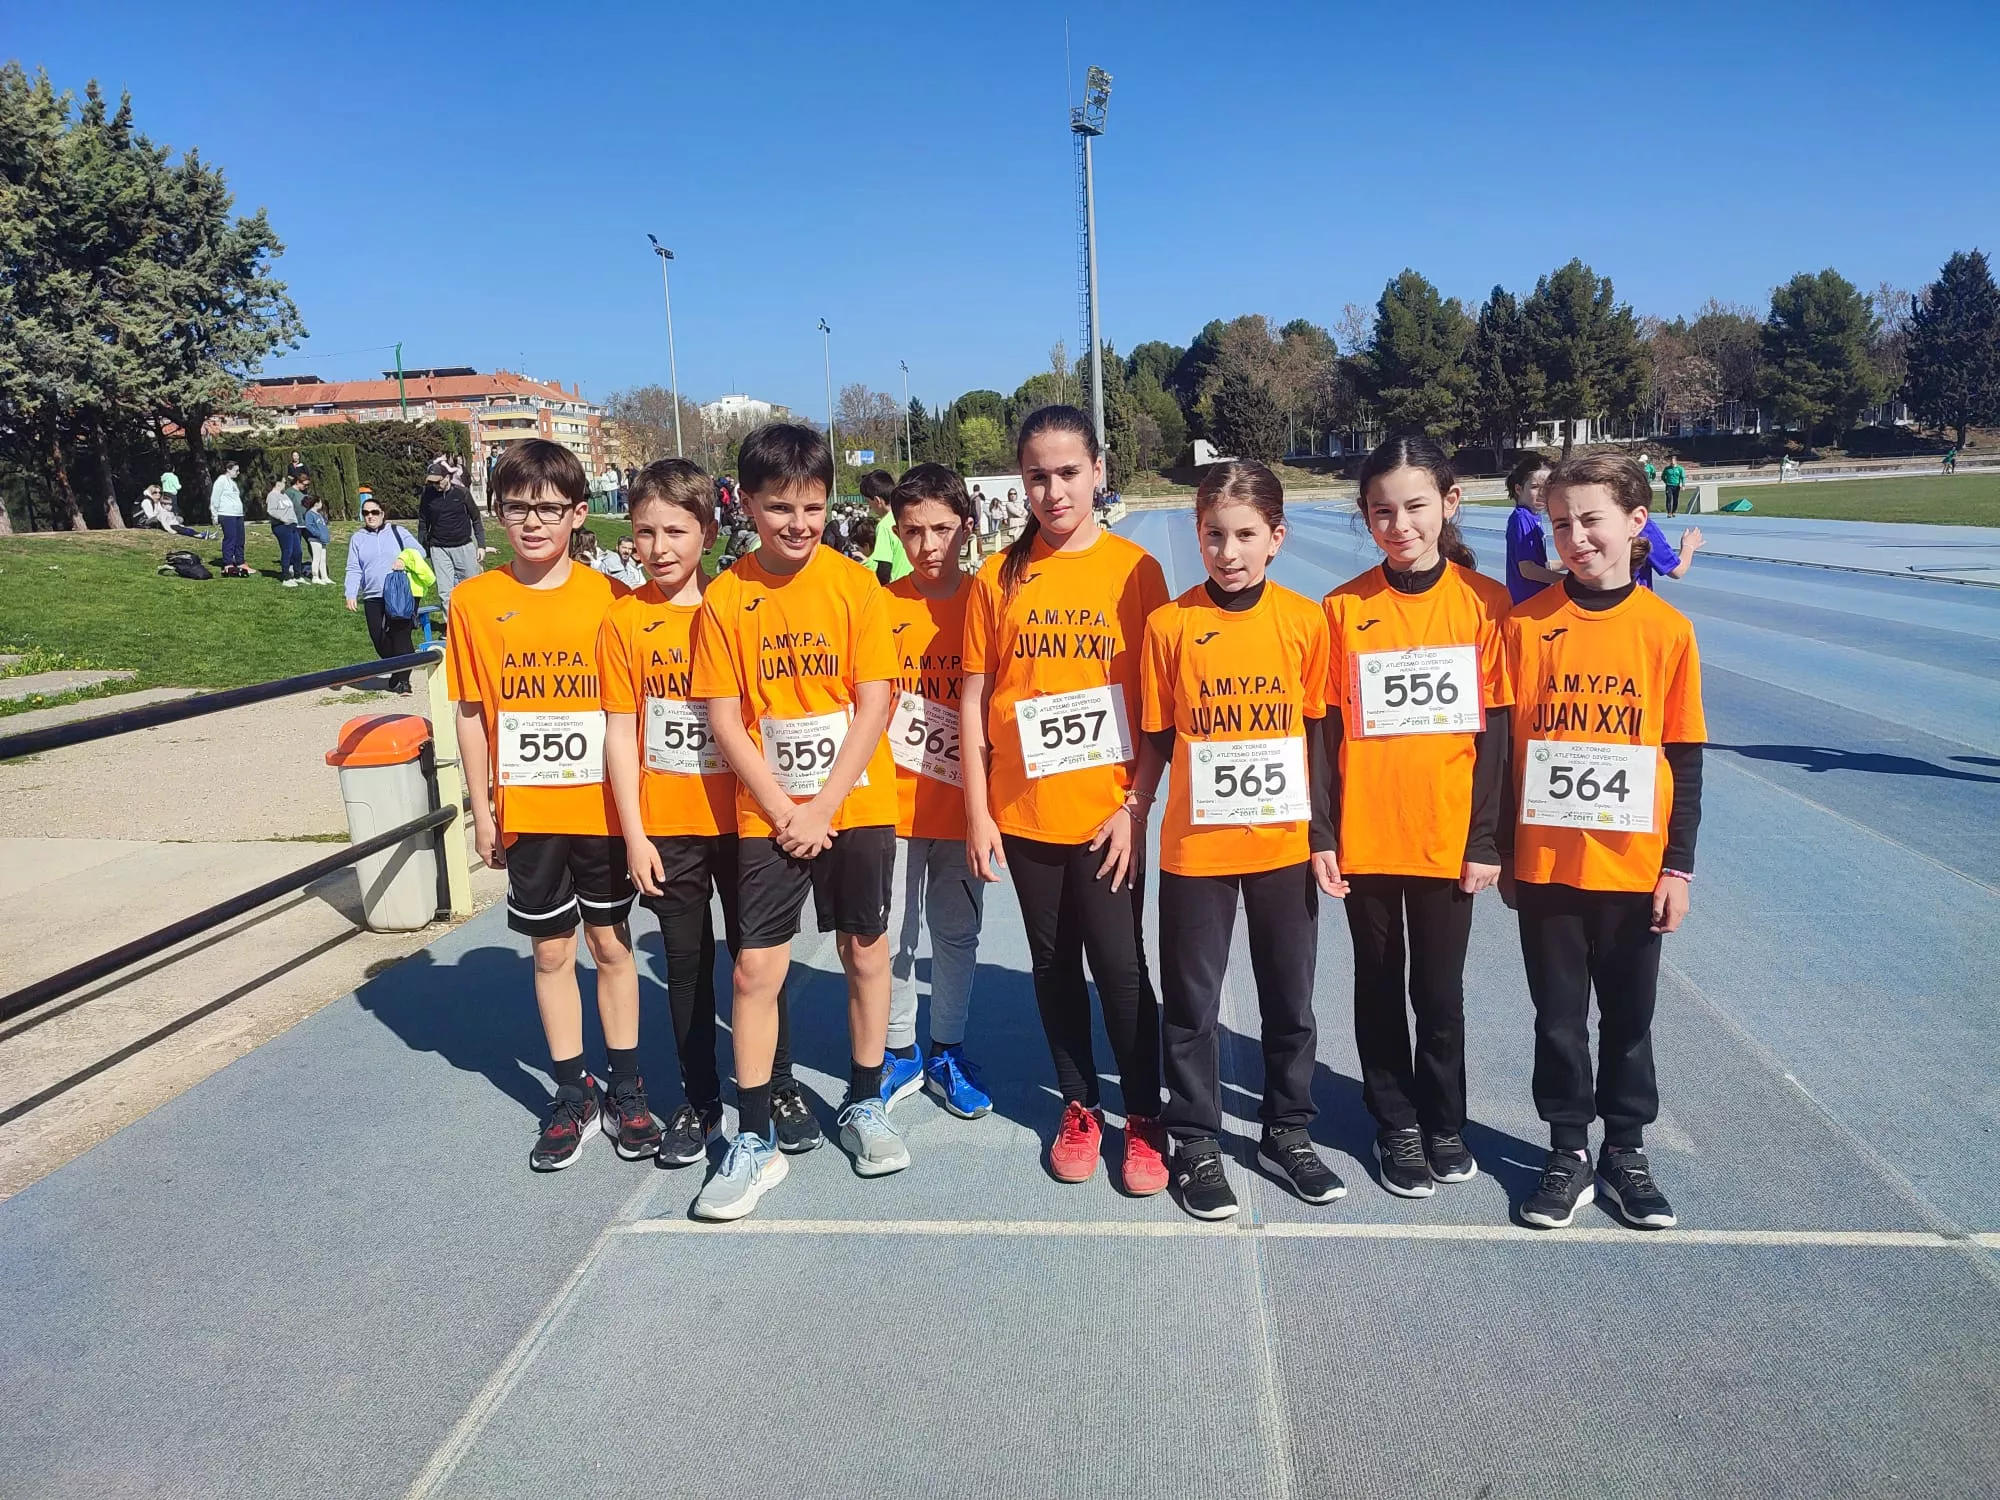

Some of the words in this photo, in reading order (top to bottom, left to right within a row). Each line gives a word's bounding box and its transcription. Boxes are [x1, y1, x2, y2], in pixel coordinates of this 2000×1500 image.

[1027, 609, 1110, 628] A.M.Y.P.A.
[762, 632, 831, 651] A.MY.P.A.
[1015, 633, 1066, 659] JUAN
[1073, 634, 1116, 661] XXIII
[504, 651, 588, 669] A.M.Y.P.A.
[761, 655, 798, 681] UAN
[800, 653, 839, 677] XXIII
[1385, 660, 1420, 668] ATLETISMO
[1421, 658, 1454, 666] DIVERTIDO
[501, 674, 545, 700] UAN
[553, 674, 598, 698] XXIII
[1064, 693, 1087, 702] TORNEO
[1200, 676, 1286, 698] A.M.Y.P.A.
[1384, 671, 1459, 708] 556
[1547, 674, 1642, 698] A.M.Y.P.A.
[1039, 703, 1071, 713] ATLETISMO
[1071, 697, 1102, 707] DIVERTIDO
[1191, 704, 1242, 735] JUAN
[1249, 703, 1293, 732] XXIII
[1533, 702, 1588, 733] JUAN
[664, 721, 716, 751] 55
[905, 717, 960, 762] 562
[1040, 710, 1107, 750] 557
[519, 732, 587, 762] 550
[775, 738, 836, 772] 559
[1251, 749, 1281, 757] DIVERTIDO
[1592, 754, 1628, 763] DIVERTIDO
[1214, 762, 1287, 798] 565
[1548, 765, 1631, 803] 564
